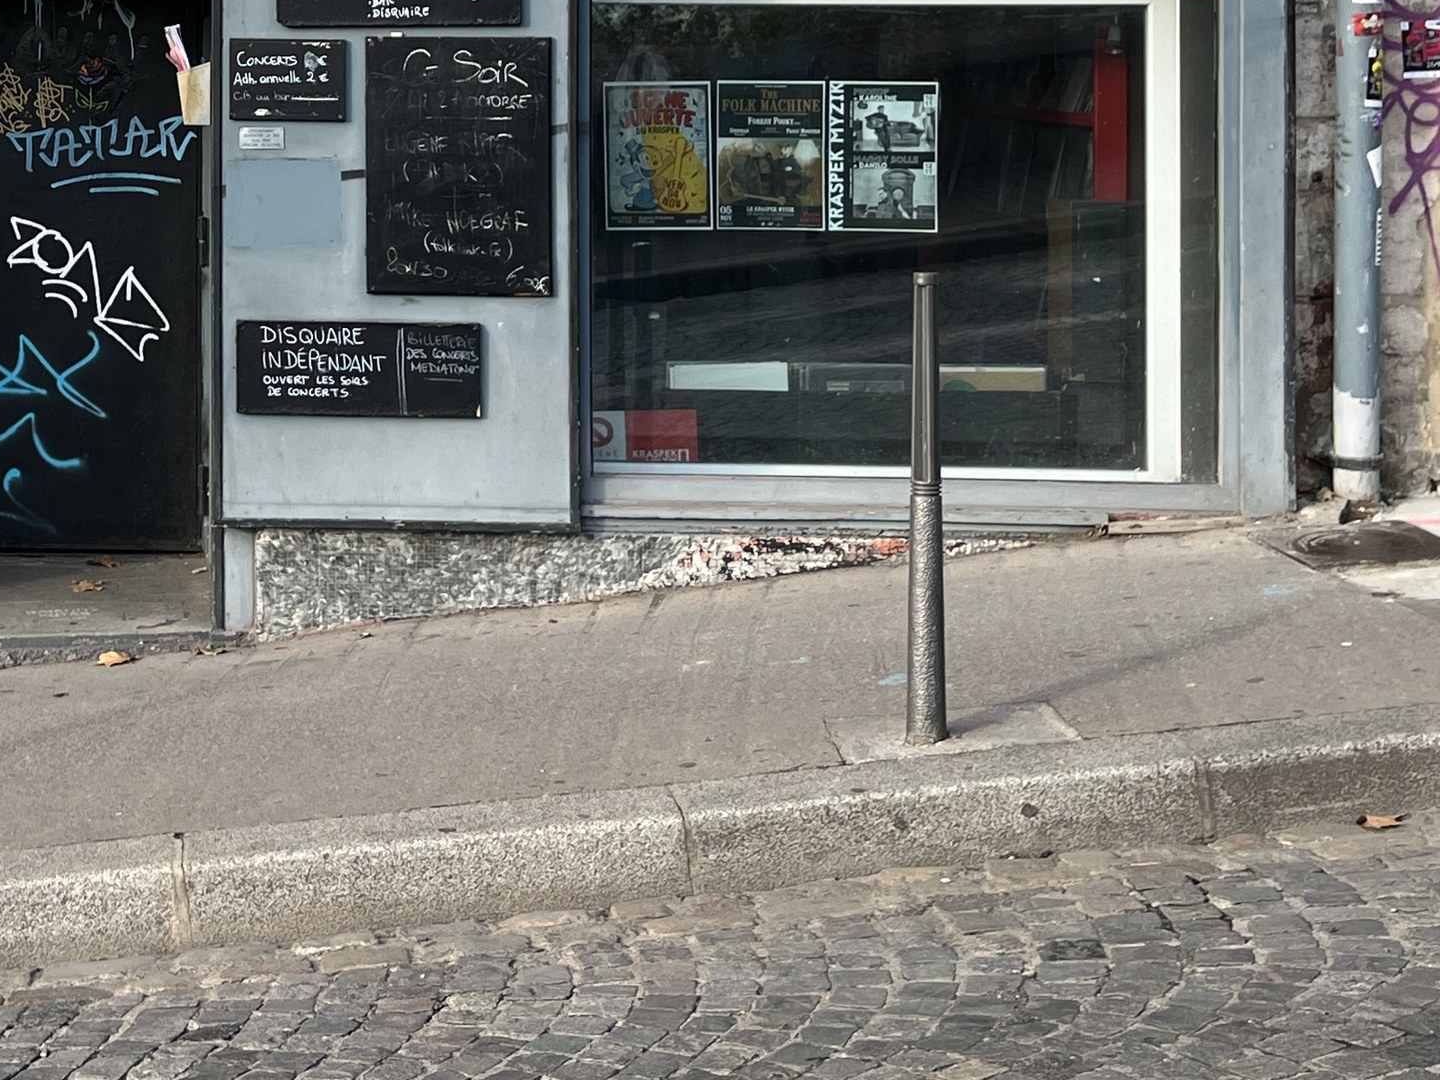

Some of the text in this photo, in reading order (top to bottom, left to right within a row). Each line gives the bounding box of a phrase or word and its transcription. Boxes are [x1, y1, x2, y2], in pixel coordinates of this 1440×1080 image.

[372, 6, 430, 19] DISQUAIRE
[236, 51, 298, 67] CONCERTS
[260, 70, 302, 83] annuelle
[761, 88, 778, 99] THE
[721, 99, 821, 113] FOLK MACHINE
[619, 108, 696, 128] OUVERTE
[829, 81, 845, 230] KRASPEK MYZIK
[260, 324, 367, 346] DISQUAIRE
[407, 331, 477, 349] BILLETTERIE
[262, 347, 387, 373] INDÉPENDANT
[405, 347, 479, 362] DES CONCERTS
[263, 375, 310, 385] OUVERT
[316, 375, 335, 385] LES
[267, 386, 349, 398] DE CONCERTS
[632, 448, 678, 458] KRASPEK
